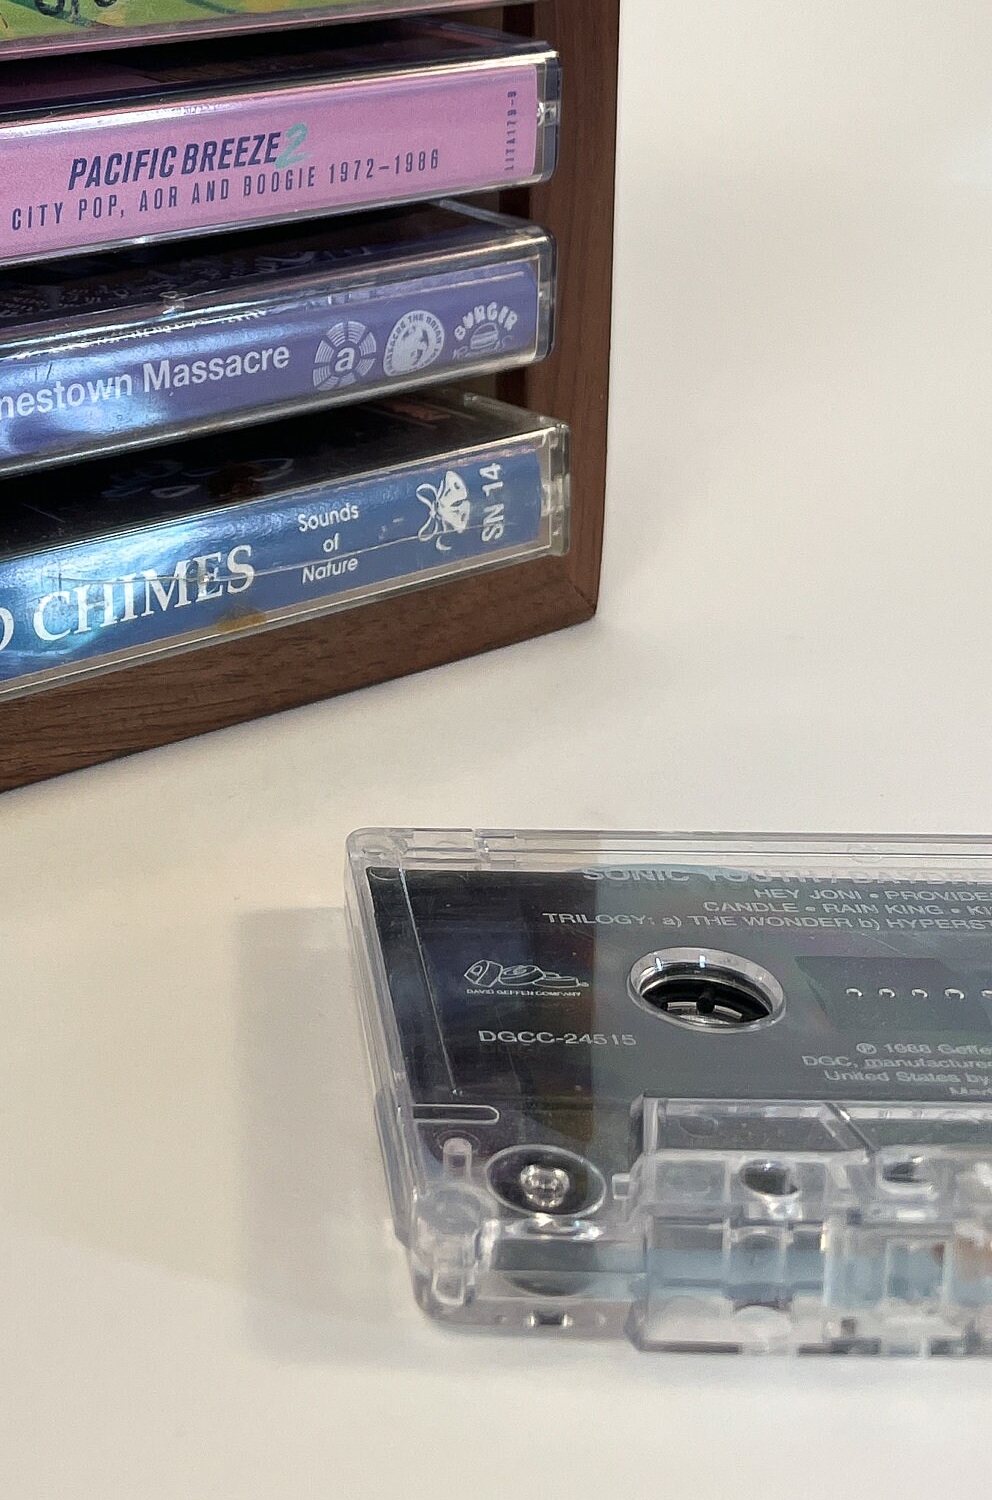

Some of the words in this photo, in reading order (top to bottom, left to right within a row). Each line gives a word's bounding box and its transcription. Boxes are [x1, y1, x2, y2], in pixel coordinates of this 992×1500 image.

[67, 146, 178, 191] PACIFIC
[180, 131, 282, 175] BREEZE
[274, 122, 312, 170] 2
[11, 202, 64, 231] CITY
[78, 195, 125, 220] POP,
[139, 188, 178, 212] AOR
[191, 179, 230, 205] AND
[243, 166, 316, 197] BOOGIE
[142, 345, 290, 394] Massacre
[478, 462, 504, 497] 14
[297, 501, 359, 532] Sounds
[481, 502, 505, 542] SN
[323, 532, 340, 553] of
[301, 556, 358, 584] Nature
[32, 544, 255, 642] CHIMES
[703, 901, 800, 912] CANDLE
[822, 903, 880, 914] RAIN
[884, 904, 944, 915] KING
[754, 889, 800, 899] HEY
[809, 889, 862, 900] JONI
[884, 890, 992, 901] PROVIDE
[542, 912, 656, 925] TRILOGY:
[662, 915, 682, 928] a)
[687, 915, 738, 926] THE
[742, 916, 853, 928] WONDER
[858, 918, 880, 930] b)
[478, 1030, 637, 1046] DGCC-24515
[801, 1055, 858, 1068] DGC,
[823, 1069, 890, 1082] United
[895, 1071, 961, 1083] States
[964, 1072, 989, 1086] by
